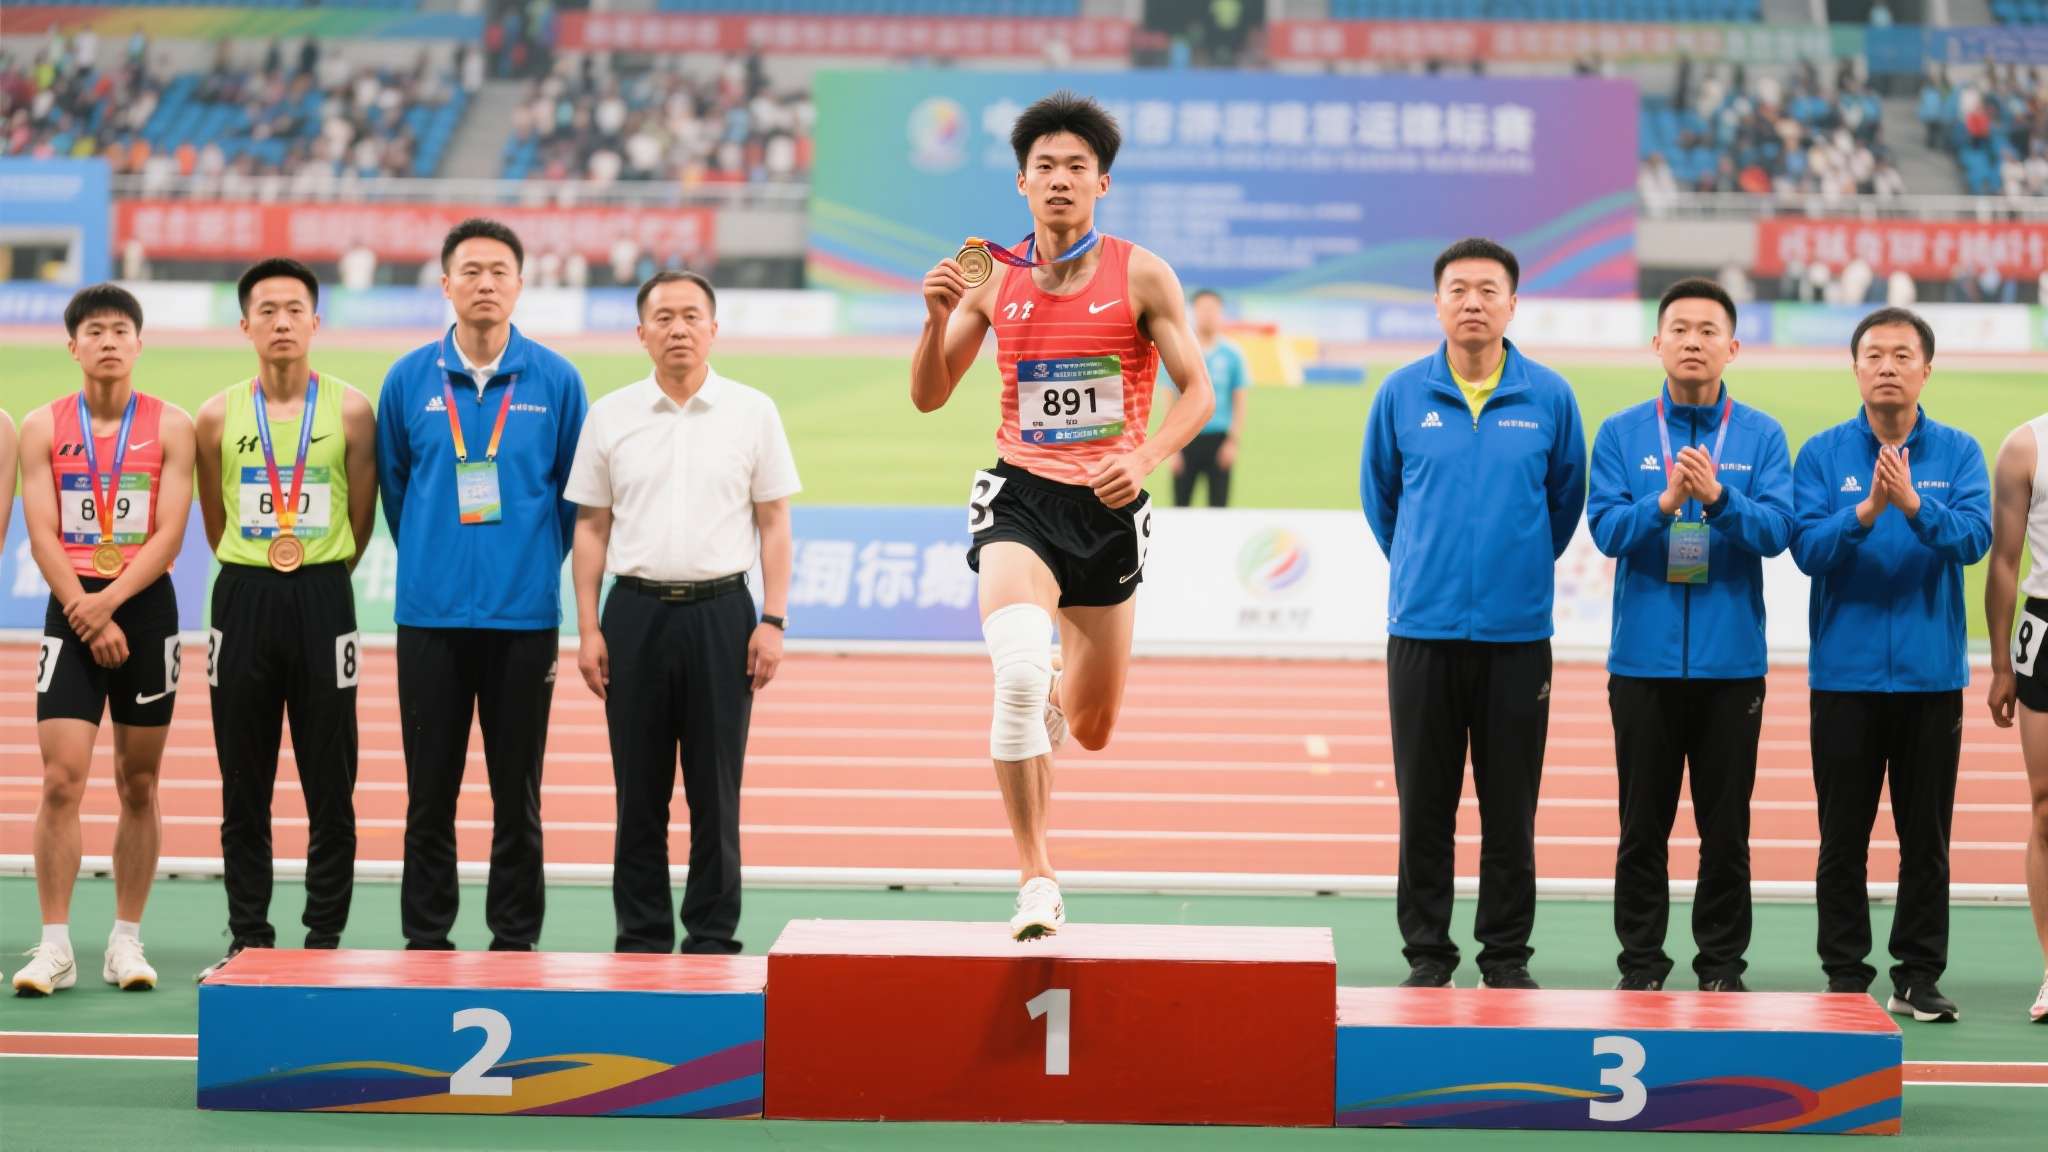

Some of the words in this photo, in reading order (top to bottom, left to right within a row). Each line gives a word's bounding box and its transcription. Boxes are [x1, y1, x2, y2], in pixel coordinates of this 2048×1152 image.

[1043, 387, 1097, 416] 891
[81, 497, 130, 521] 89
[344, 641, 356, 679] 8
[450, 1008, 513, 1095] 2
[1027, 990, 1070, 1075] 1
[1590, 1036, 1647, 1122] 3
